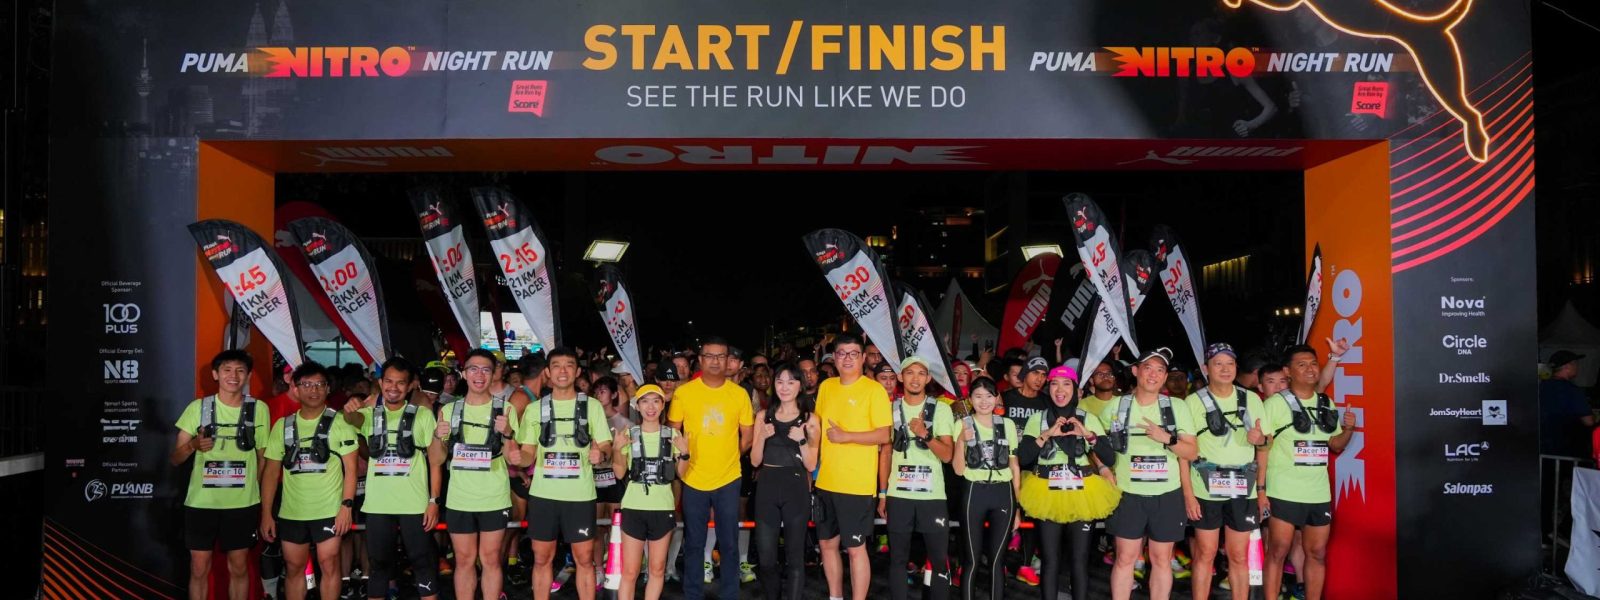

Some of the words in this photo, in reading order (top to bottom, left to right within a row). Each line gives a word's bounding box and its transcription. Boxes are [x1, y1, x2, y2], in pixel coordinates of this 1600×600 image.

[180, 52, 249, 73] PUMA
[256, 46, 412, 78] NITRO
[422, 51, 496, 71] NIGHT
[500, 51, 553, 71] RUN
[1029, 51, 1097, 72] PUMA
[1101, 46, 1256, 78] NITRO
[1266, 52, 1339, 73] NIGHT
[1343, 52, 1394, 73] RUN
[626, 85, 677, 108] SEE
[685, 85, 737, 108] THE
[747, 85, 804, 108] RUN
[814, 85, 872, 108] LIKE
[881, 85, 922, 108] WE
[931, 85, 967, 108] DO
[513, 99, 540, 109] Score
[1356, 101, 1382, 110] Score
[594, 145, 993, 165] NITRO
[500, 241, 538, 274] 2:15
[515, 277, 548, 300] PACER
[250, 296, 283, 323] ACER
[853, 294, 883, 322] PACER
[1014, 282, 1054, 337] PUMA
[1441, 296, 1484, 309] Nova
[103, 303, 141, 323] 100
[105, 324, 138, 334] PLUS
[1442, 334, 1487, 349] Circle
[104, 360, 139, 379] N8
[1439, 373, 1490, 383] Dr.Smells
[1332, 268, 1366, 511] NITRO
[1429, 407, 1482, 418] JomSayHeart
[456, 450, 478, 458] Pacer
[1297, 447, 1319, 455] Pacer
[1445, 444, 1480, 457] LAC
[207, 467, 230, 475] Pacer
[233, 467, 243, 475] 10
[1133, 462, 1154, 470] Pacer
[1157, 462, 1165, 470] 17
[1211, 478, 1231, 486] Pace
[1236, 478, 1245, 486] 20
[1443, 482, 1493, 496] Salonpas
